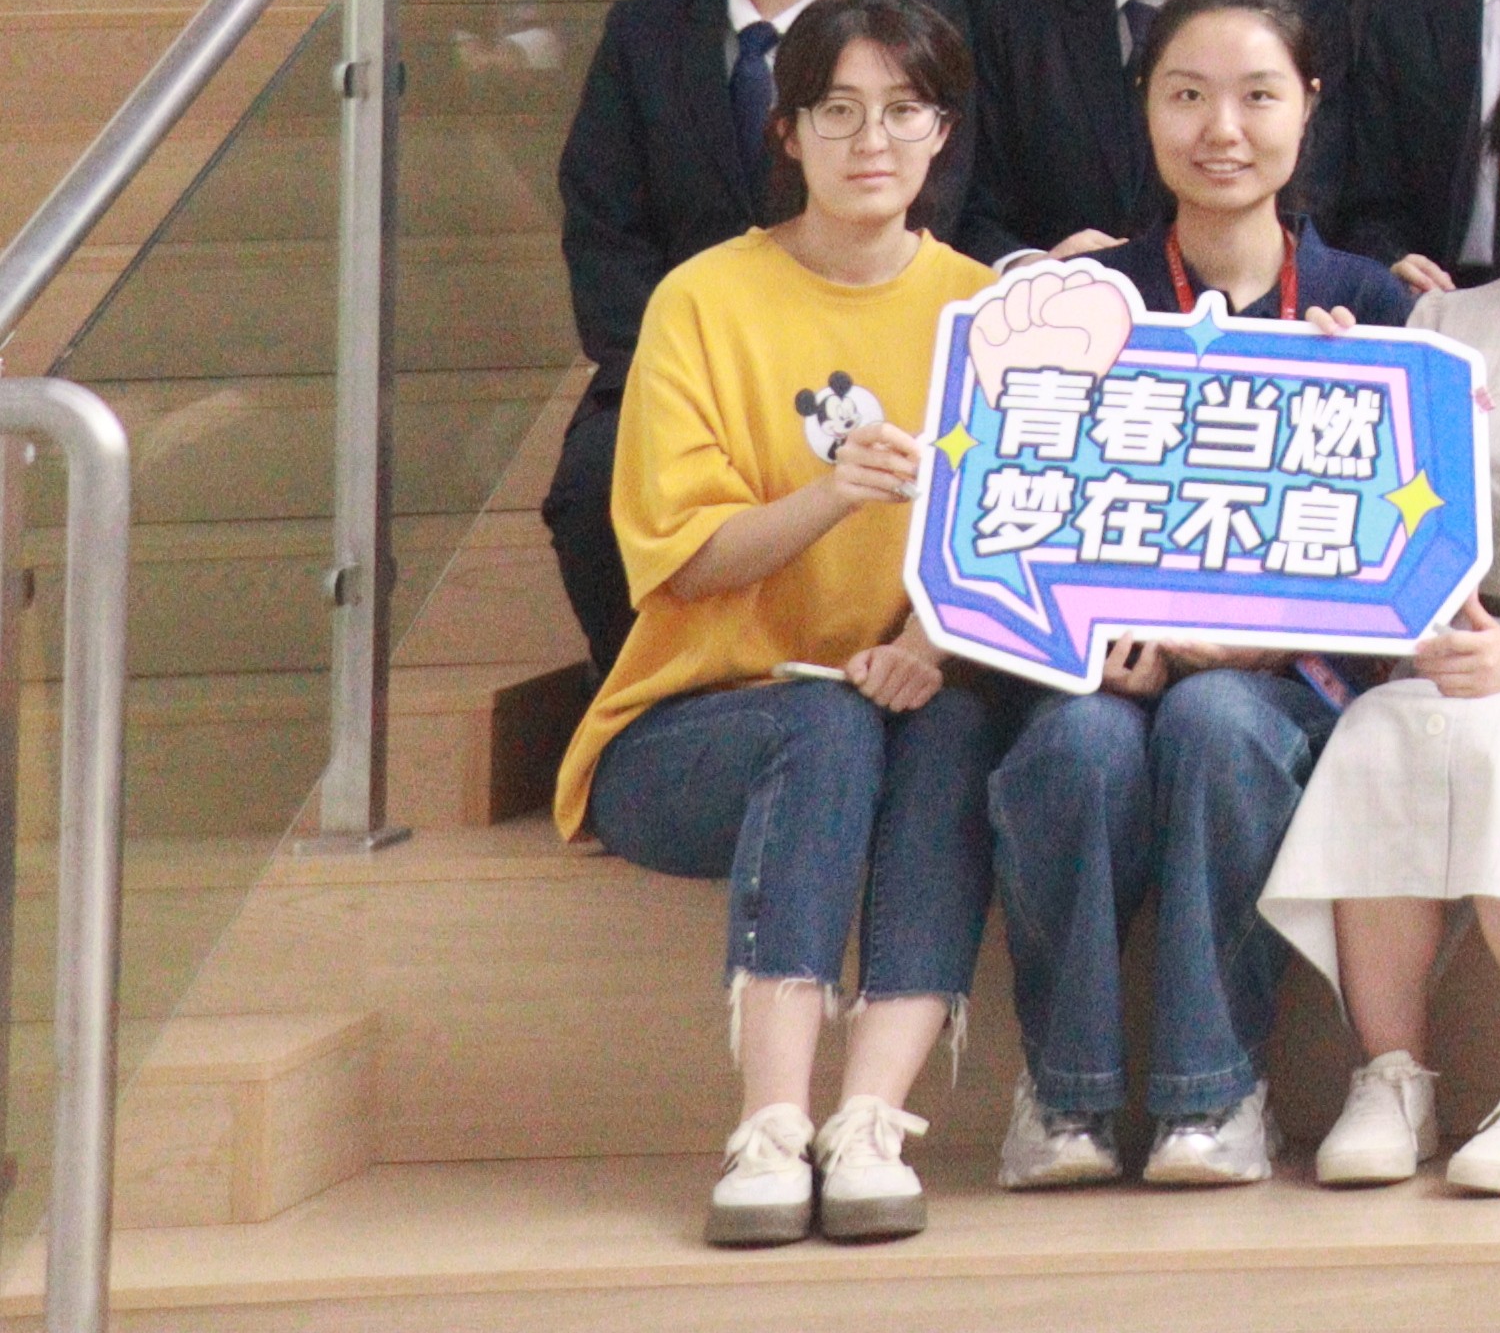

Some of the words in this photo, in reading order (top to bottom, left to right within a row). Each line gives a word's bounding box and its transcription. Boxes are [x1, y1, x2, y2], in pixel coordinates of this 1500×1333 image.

[994, 366, 1384, 480] 青春当燃
[972, 465, 1362, 577] 梦在不息
